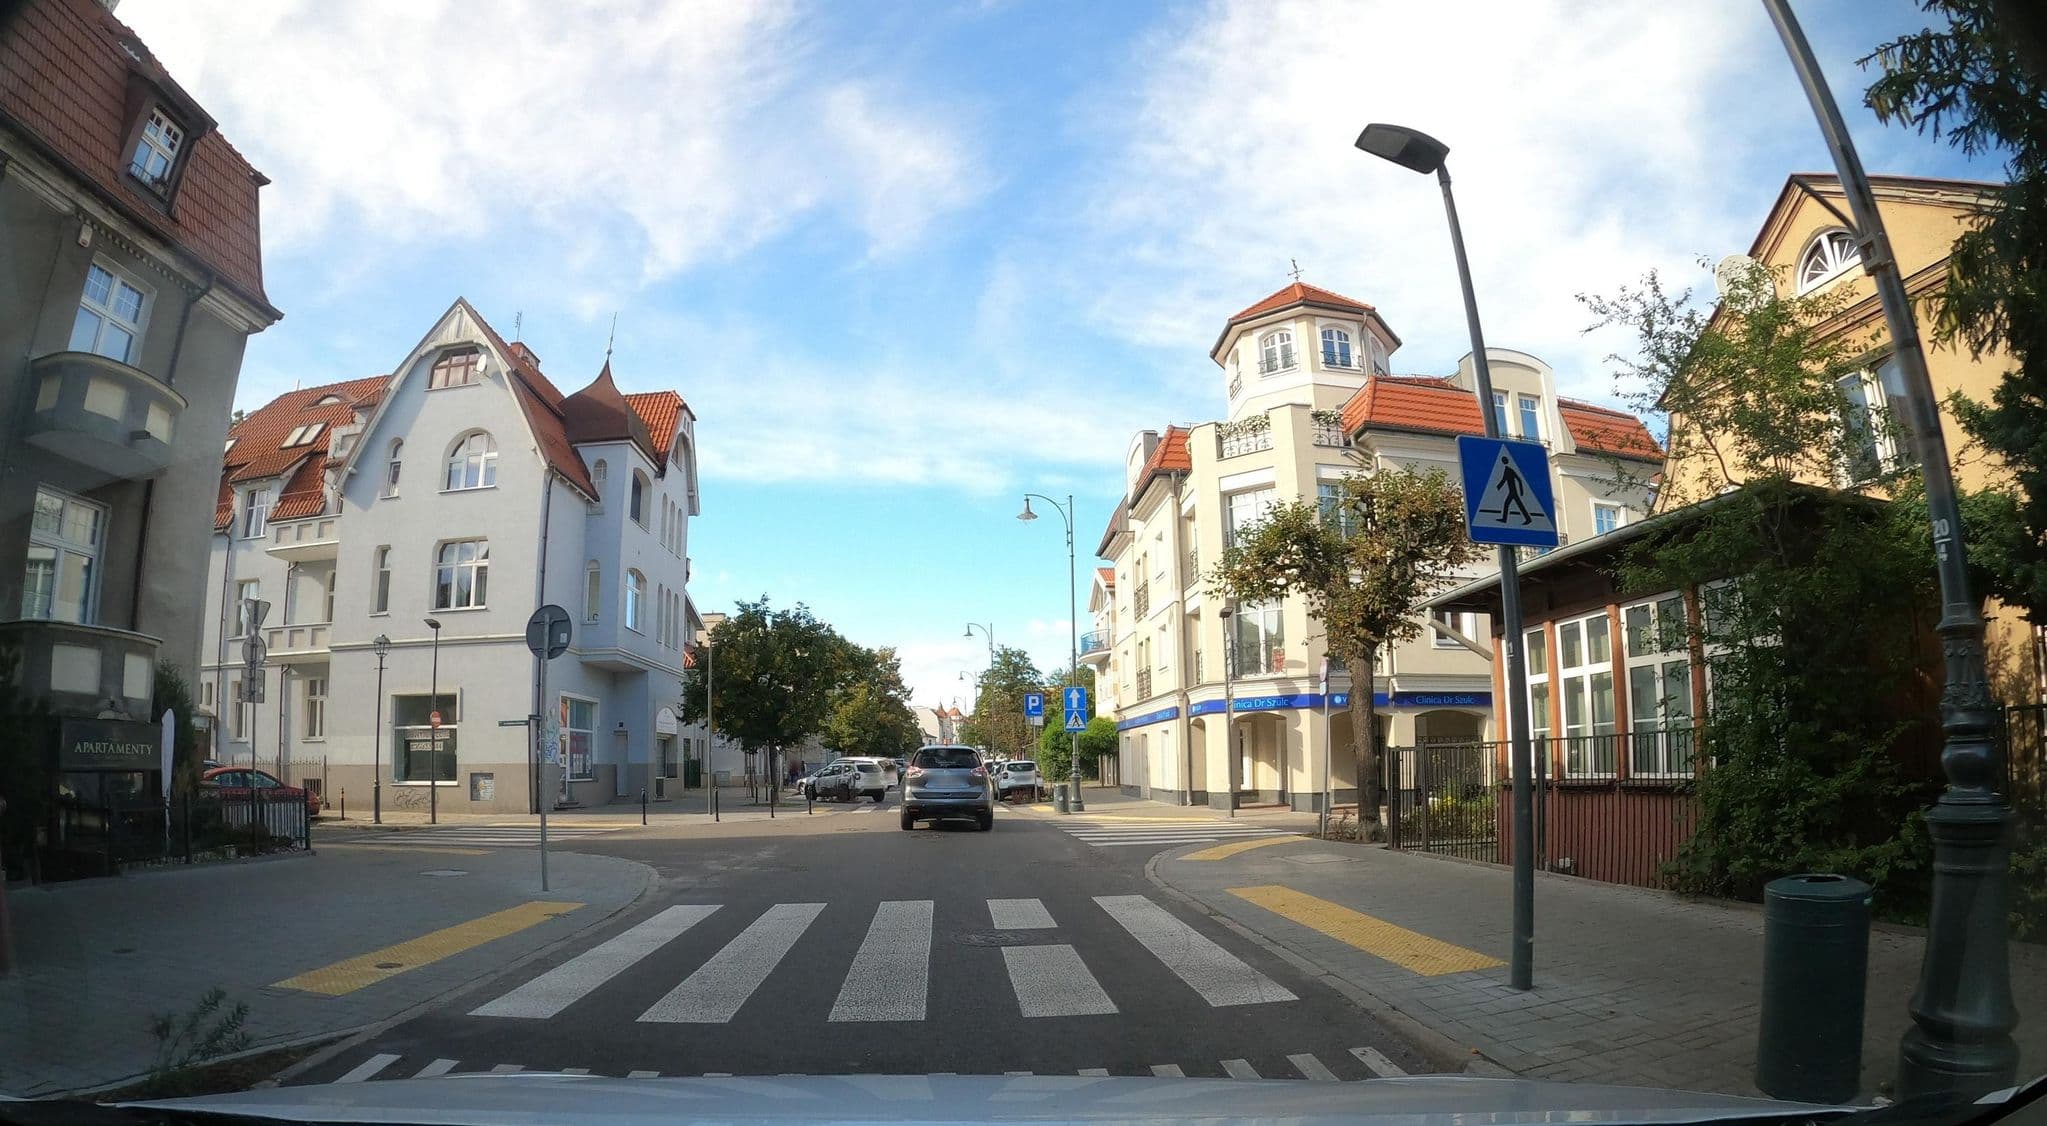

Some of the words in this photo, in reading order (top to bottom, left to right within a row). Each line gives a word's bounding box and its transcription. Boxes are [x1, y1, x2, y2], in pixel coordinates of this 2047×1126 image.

[1028, 695, 1040, 710] P
[1254, 698, 1266, 708] Dr
[1266, 697, 1289, 706] Szulc
[1415, 695, 1442, 704] Clinica
[1443, 695, 1453, 704] Dr
[74, 742, 153, 755] APARTAMENTY
